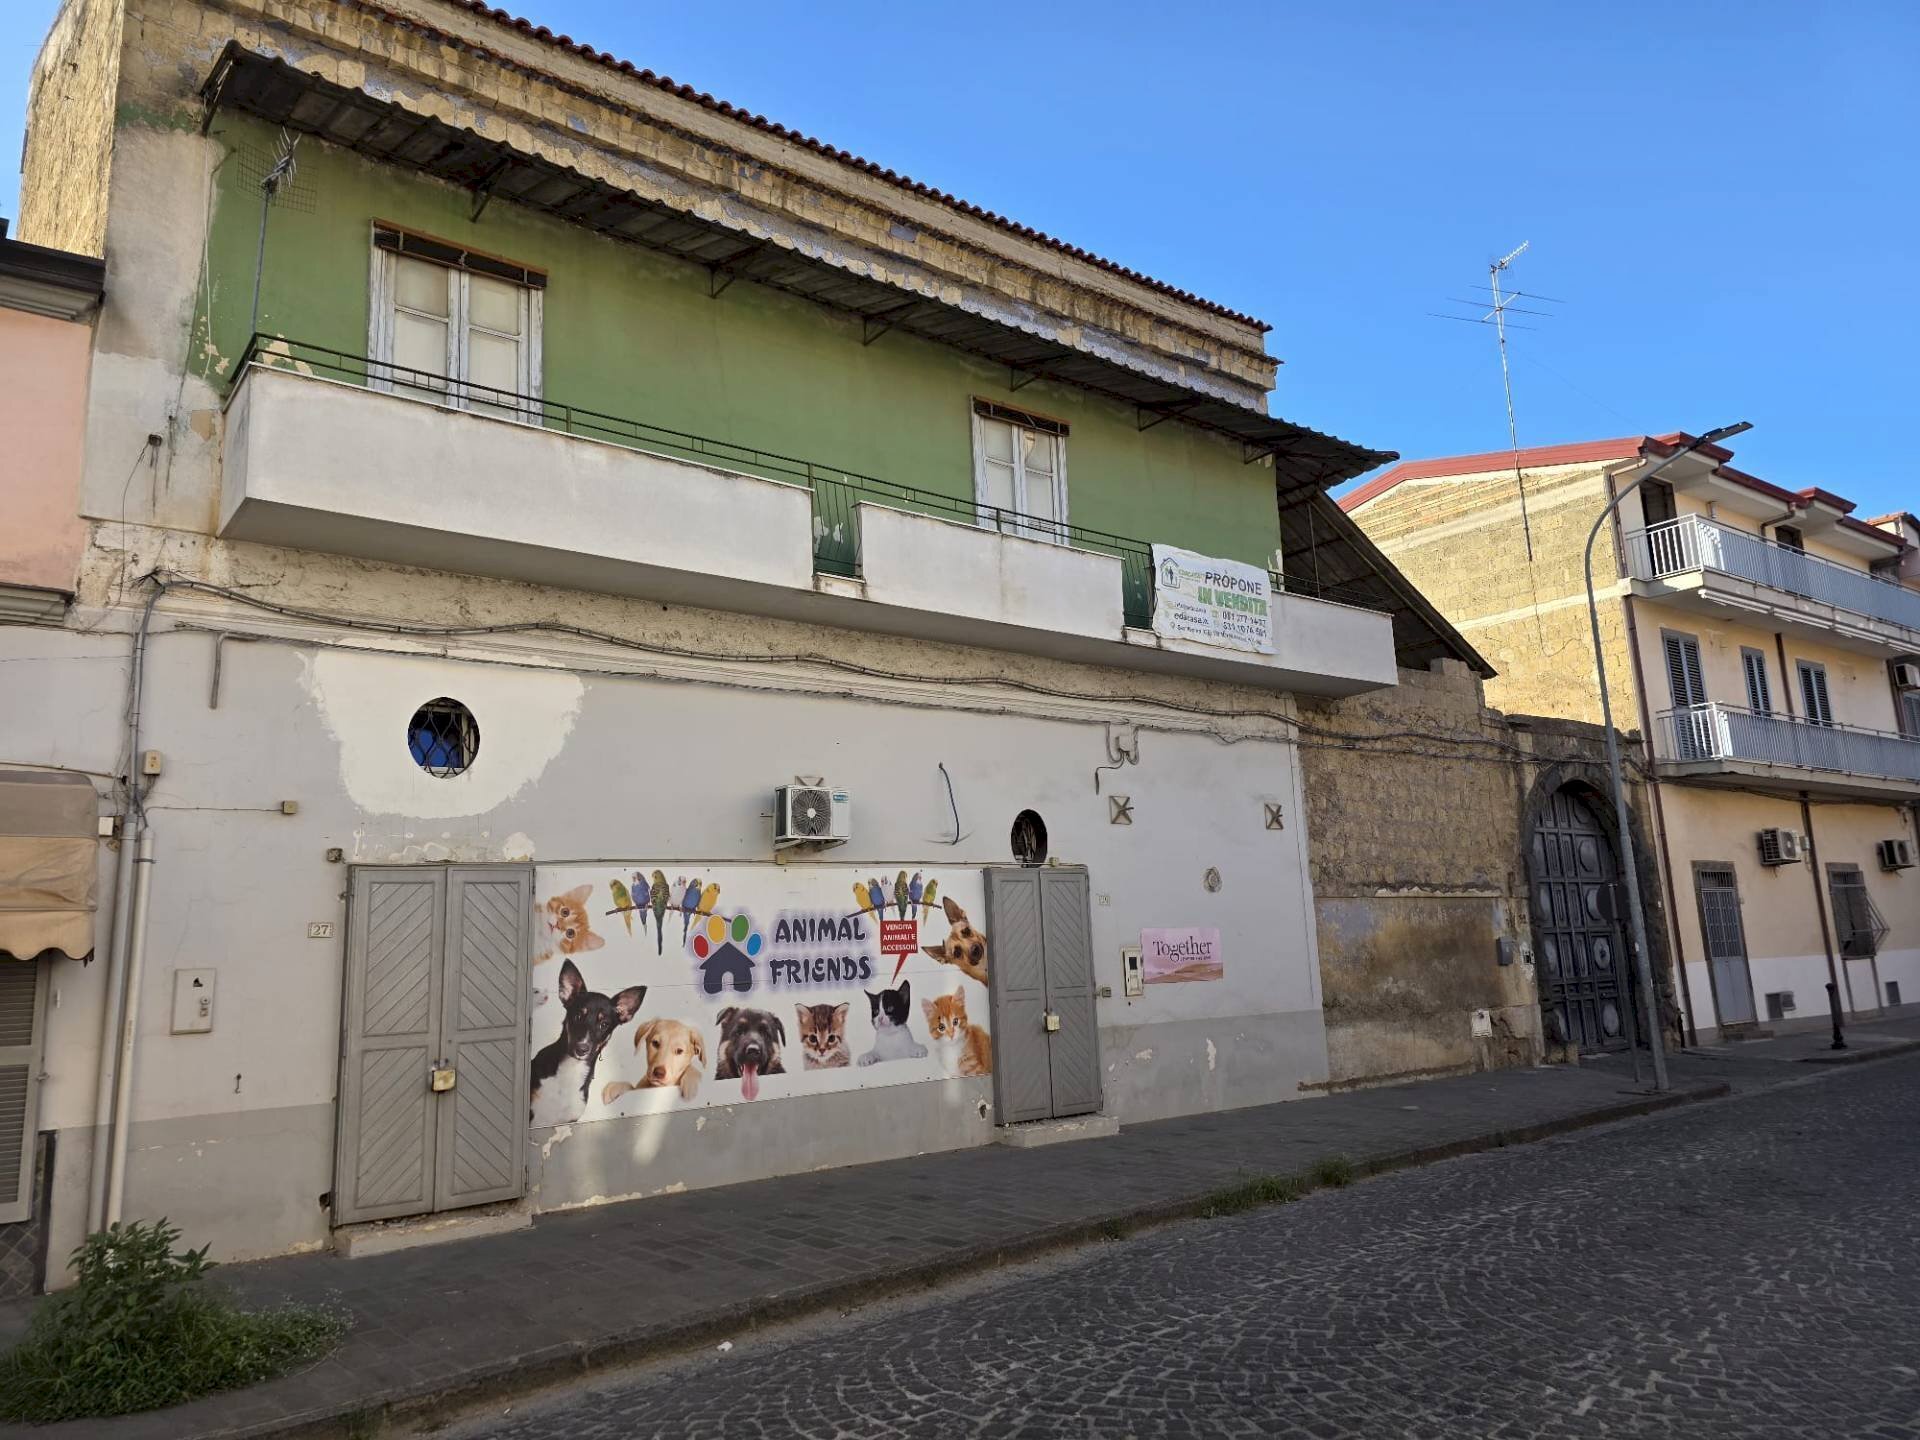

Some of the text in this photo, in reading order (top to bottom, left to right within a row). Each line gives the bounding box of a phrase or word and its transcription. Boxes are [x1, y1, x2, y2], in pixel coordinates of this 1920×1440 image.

[1204, 571, 1262, 596] PROPONE
[1197, 586, 1212, 605] IN
[1214, 588, 1268, 616] VENDITA
[313, 924, 329, 936] 27
[775, 917, 866, 943] ANIMAL
[882, 933, 910, 941] ANIMALI
[885, 923, 913, 931] VENDITA
[882, 943, 917, 951] ACCESSORI
[1152, 935, 1213, 962] Together
[769, 955, 872, 985] FRIENDS
